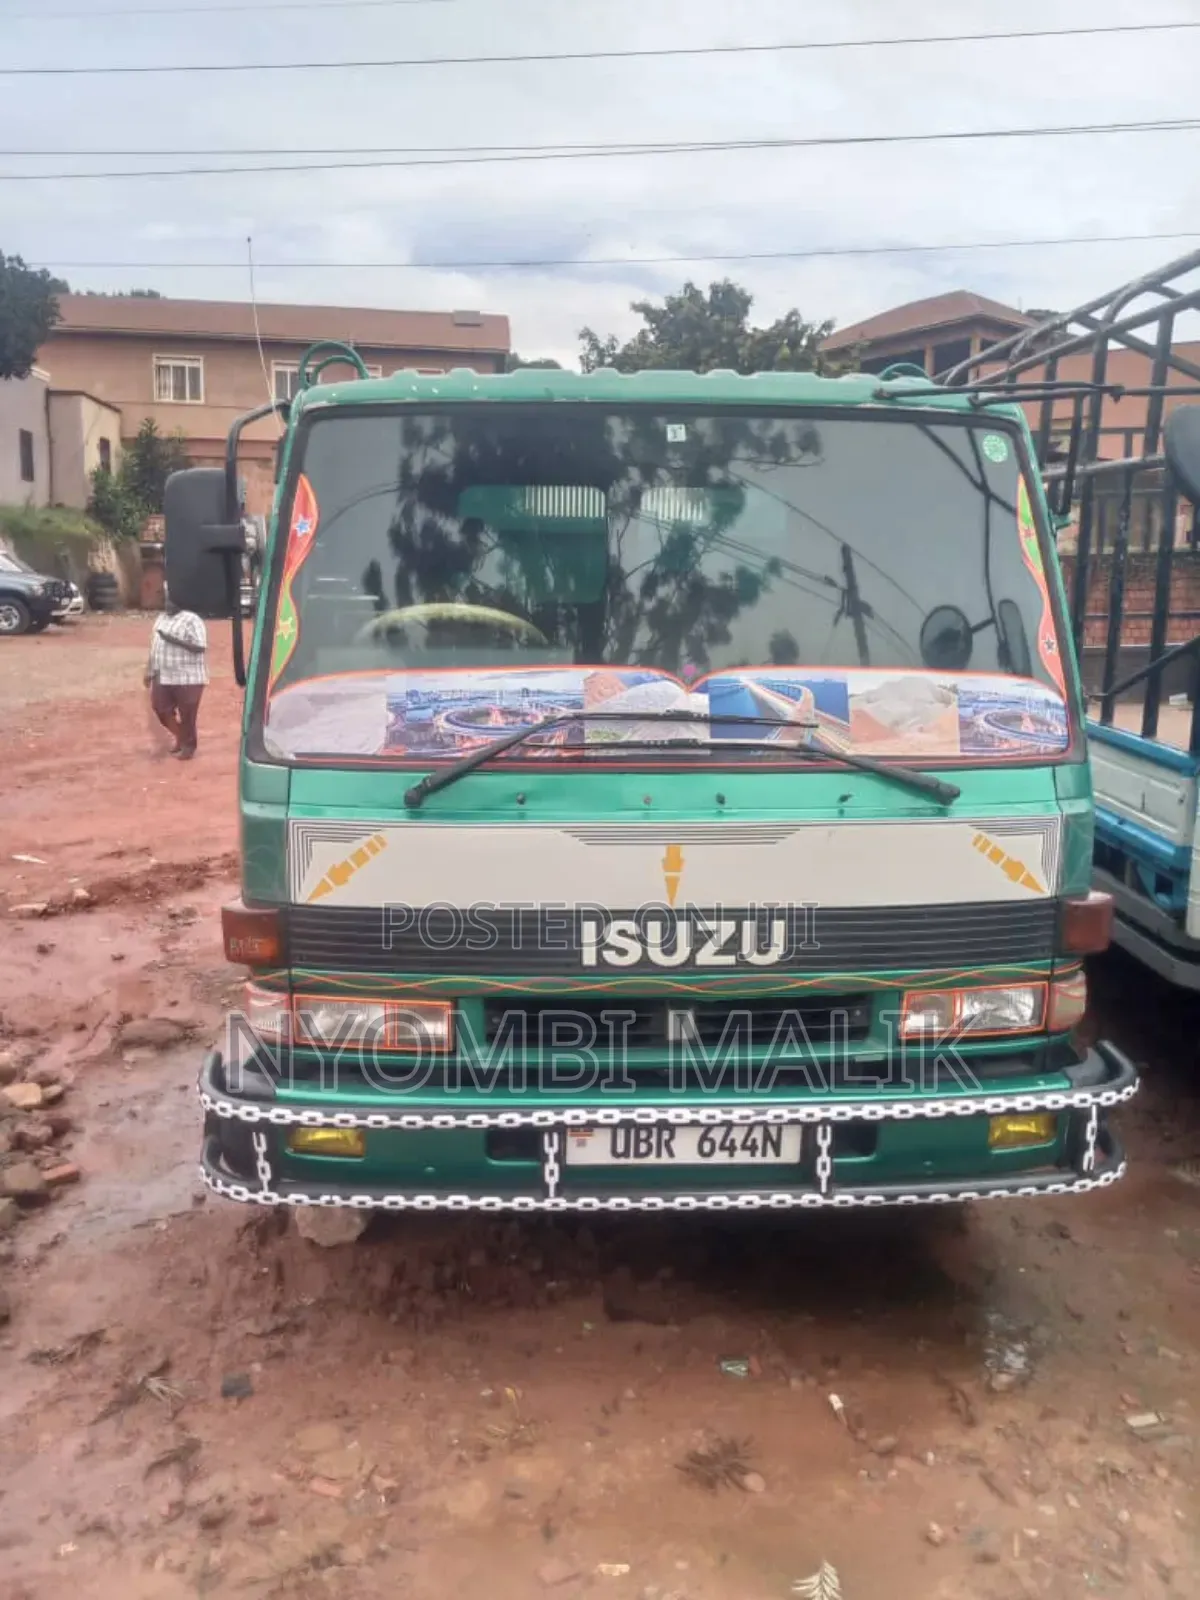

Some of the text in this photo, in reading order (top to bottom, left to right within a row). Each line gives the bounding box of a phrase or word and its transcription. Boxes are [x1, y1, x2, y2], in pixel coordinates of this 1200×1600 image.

[581, 920, 786, 967] ISUZU
[611, 1124, 783, 1159] UBR 644N
